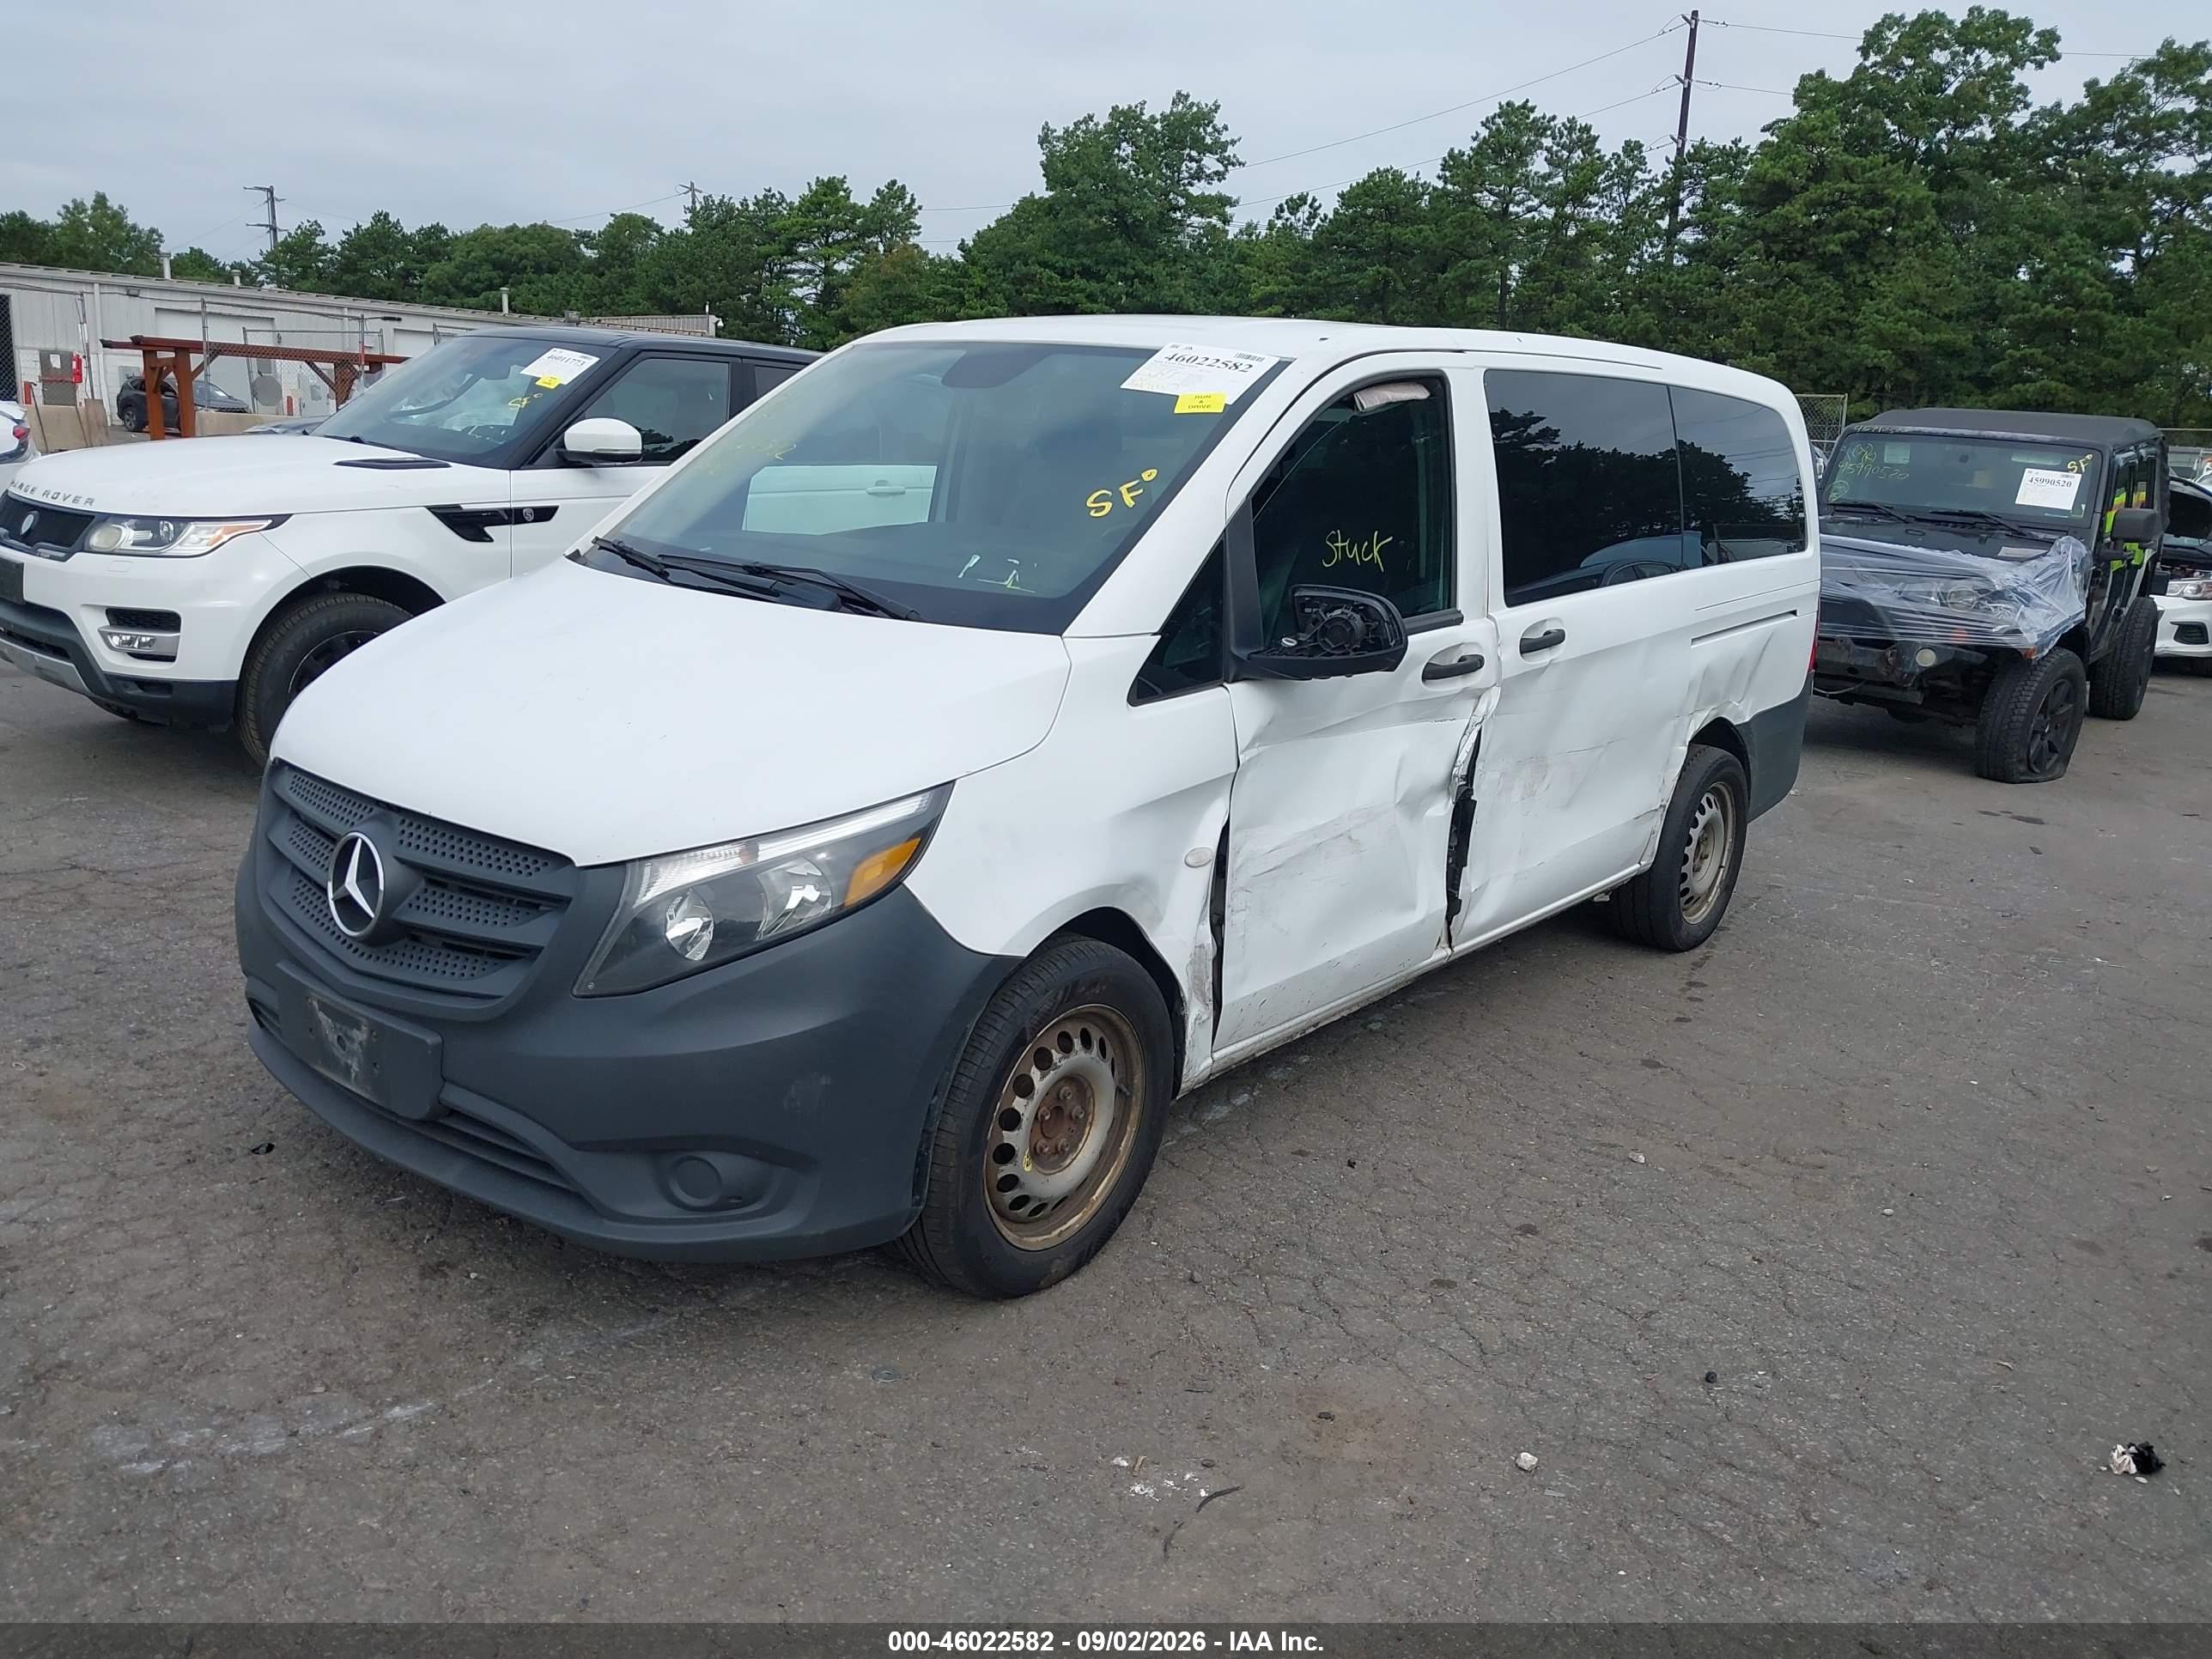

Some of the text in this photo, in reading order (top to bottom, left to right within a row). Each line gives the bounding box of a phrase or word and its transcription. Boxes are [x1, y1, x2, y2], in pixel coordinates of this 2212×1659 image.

[1164, 352, 1254, 373] 46022582
[2027, 477, 2072, 488] 45990520
[41, 489, 96, 507] ROVER
[1322, 529, 1394, 573] Stuck
